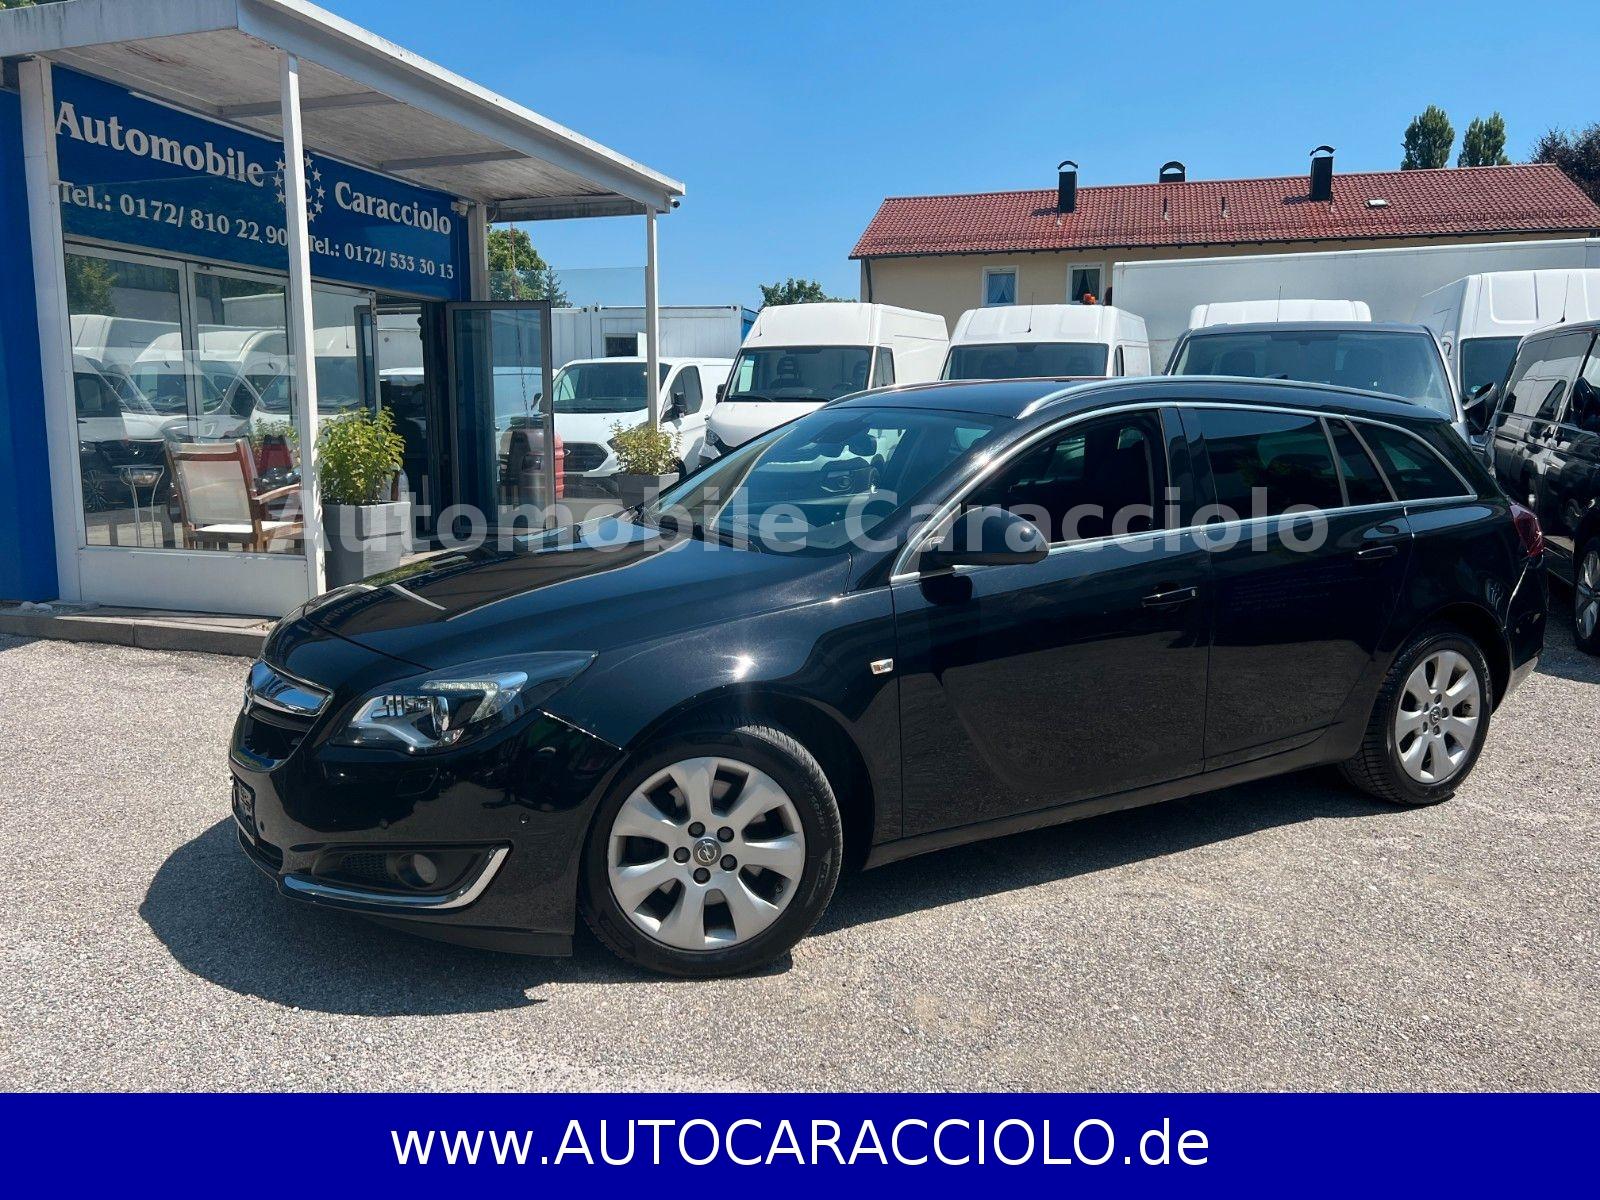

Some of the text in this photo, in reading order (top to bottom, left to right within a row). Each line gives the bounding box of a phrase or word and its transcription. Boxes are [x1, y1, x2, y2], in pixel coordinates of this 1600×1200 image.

[55, 101, 452, 235] Automobile Caracciolo
[58, 180, 288, 247] Tel.: 0172/ 810 22 90
[344, 242, 386, 268] 0172/
[390, 252, 415, 272] 533
[419, 258, 435, 276] 30
[439, 263, 454, 279] 13
